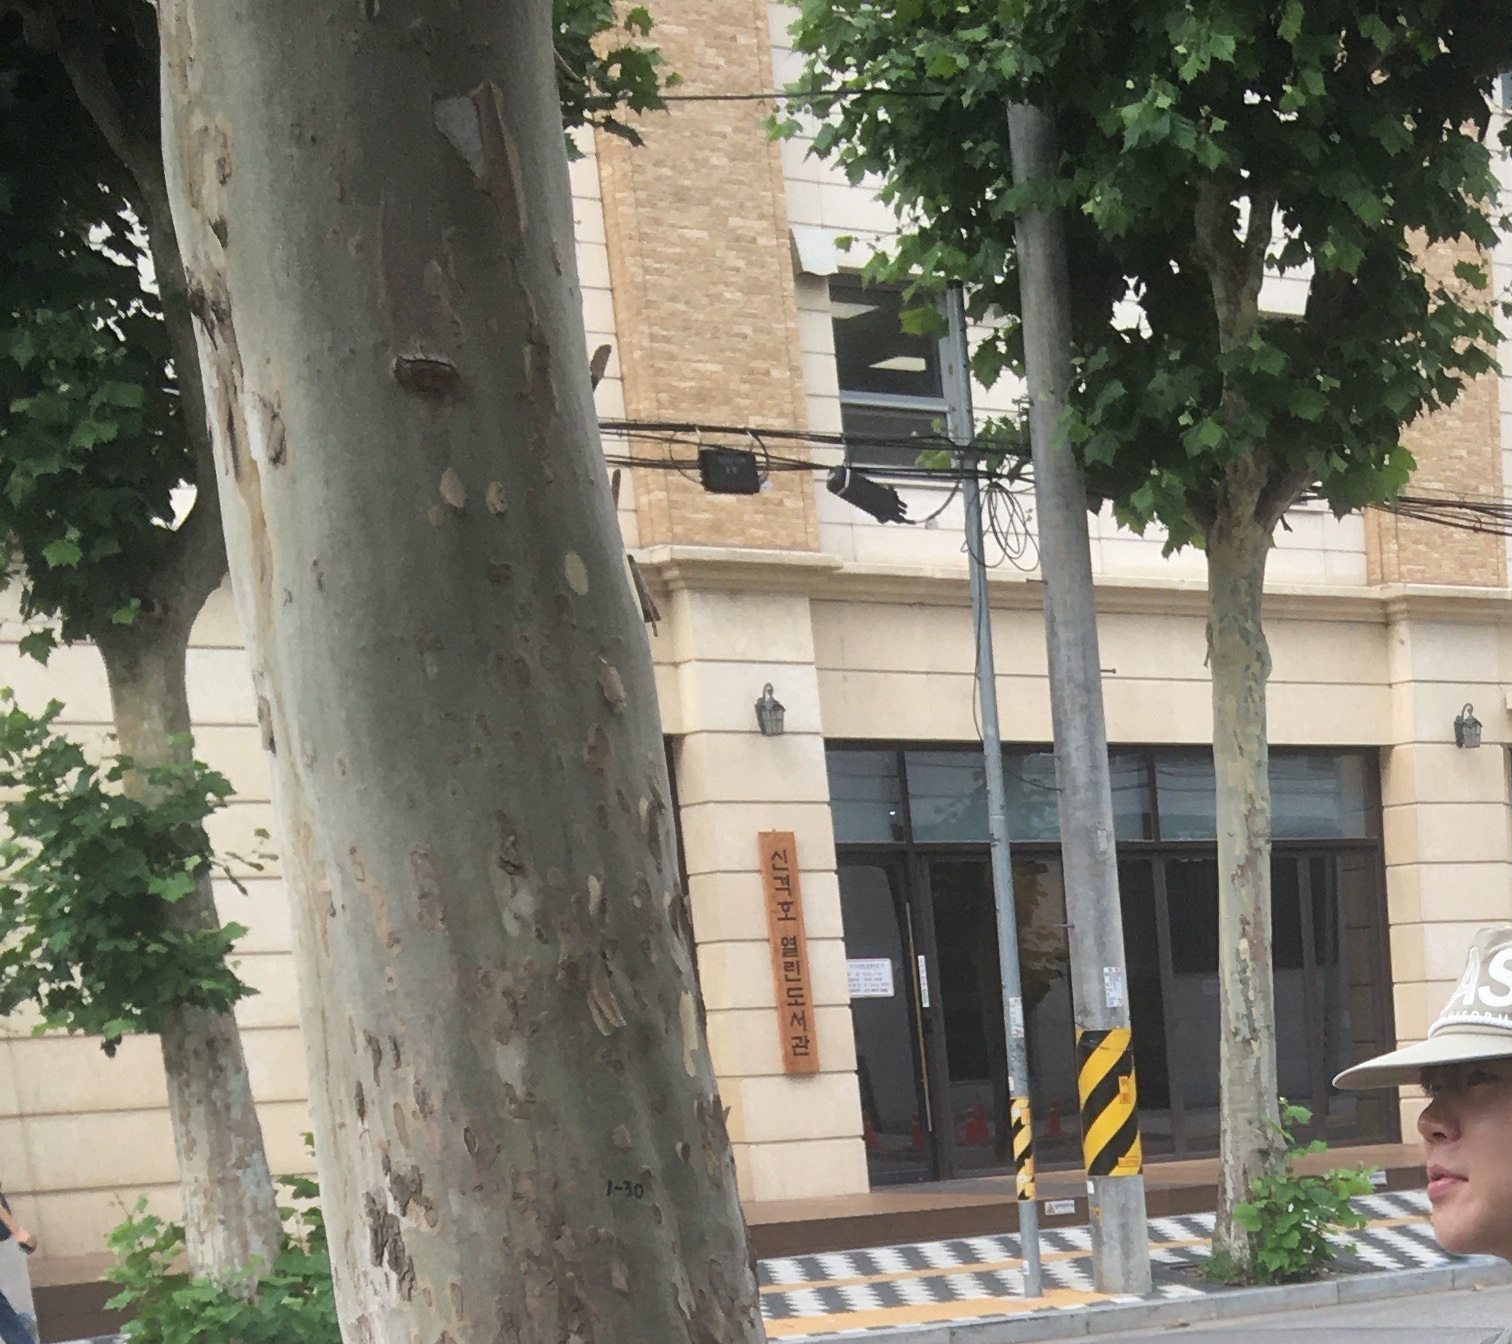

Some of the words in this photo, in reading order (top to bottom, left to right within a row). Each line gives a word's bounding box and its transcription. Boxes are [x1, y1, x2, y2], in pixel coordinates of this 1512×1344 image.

[771, 849, 797, 921] 신격호
[781, 935, 810, 1057] 열린도서관
[607, 1180, 644, 1200] 1-30
